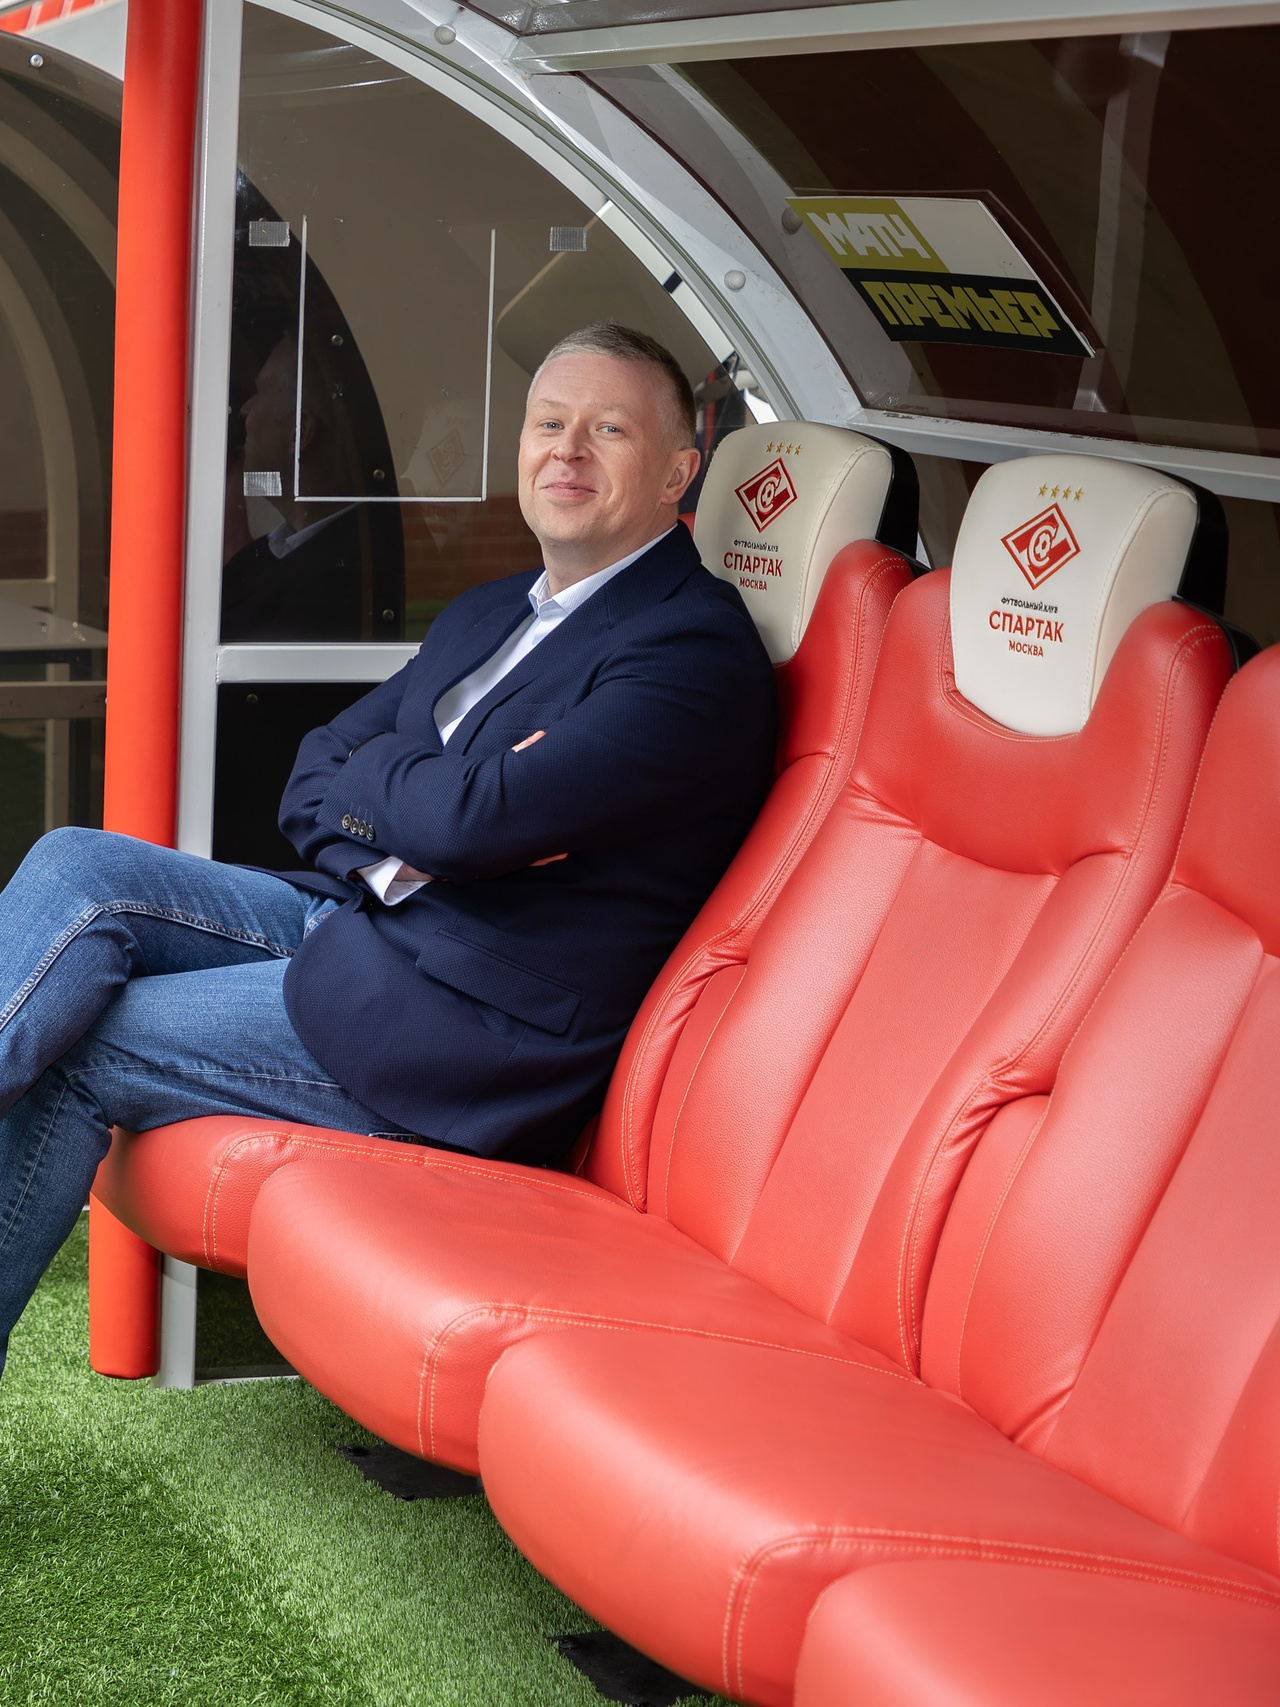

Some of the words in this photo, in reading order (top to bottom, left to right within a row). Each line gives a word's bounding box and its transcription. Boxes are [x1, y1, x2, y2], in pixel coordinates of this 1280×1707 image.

[806, 212, 931, 259] МАТЧ
[860, 281, 1061, 339] ПРЕМЬЕР
[723, 551, 783, 577] СПАРТАК
[739, 576, 767, 591] МОСКВА
[988, 610, 1064, 643] СПАРТАК
[1008, 640, 1044, 657] МОСКВА
